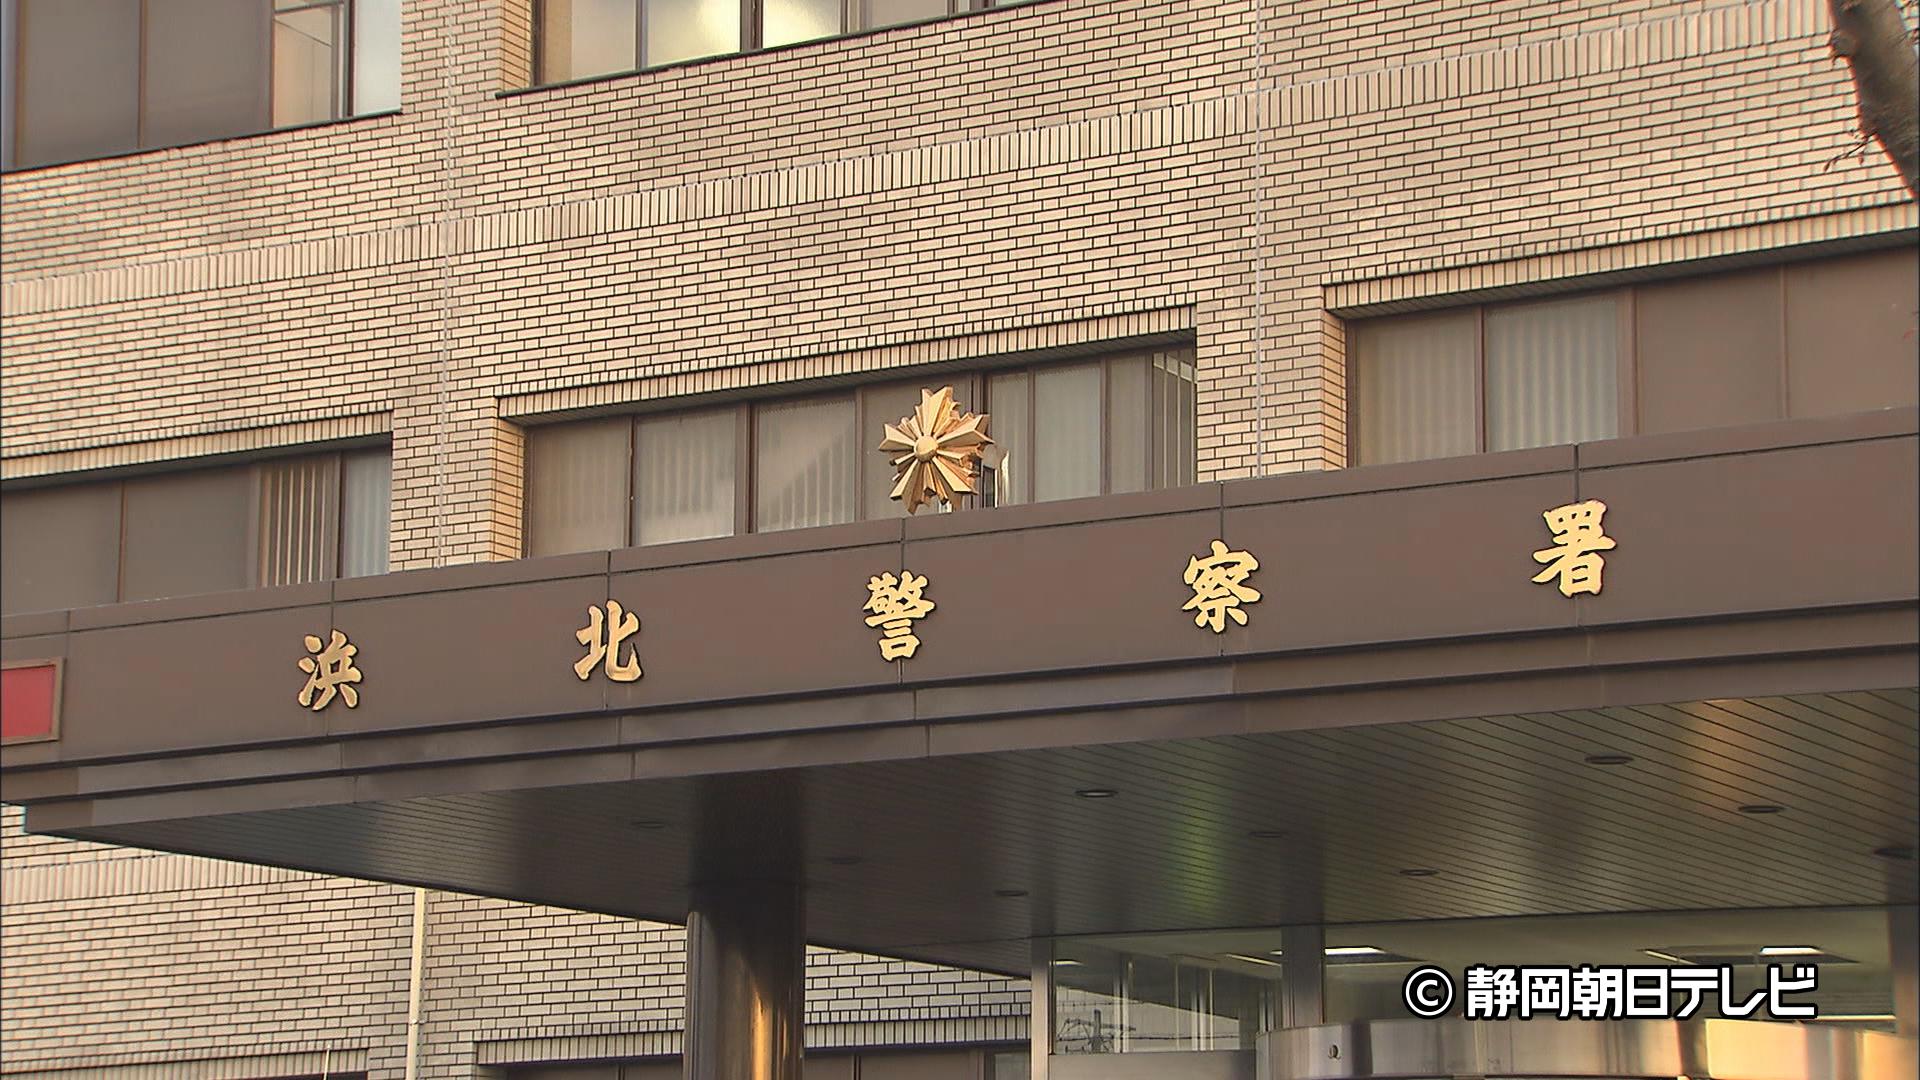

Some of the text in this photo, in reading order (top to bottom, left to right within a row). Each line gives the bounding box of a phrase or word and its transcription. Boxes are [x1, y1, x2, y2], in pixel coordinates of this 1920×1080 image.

[298, 499, 1618, 711] 浜北警察署
